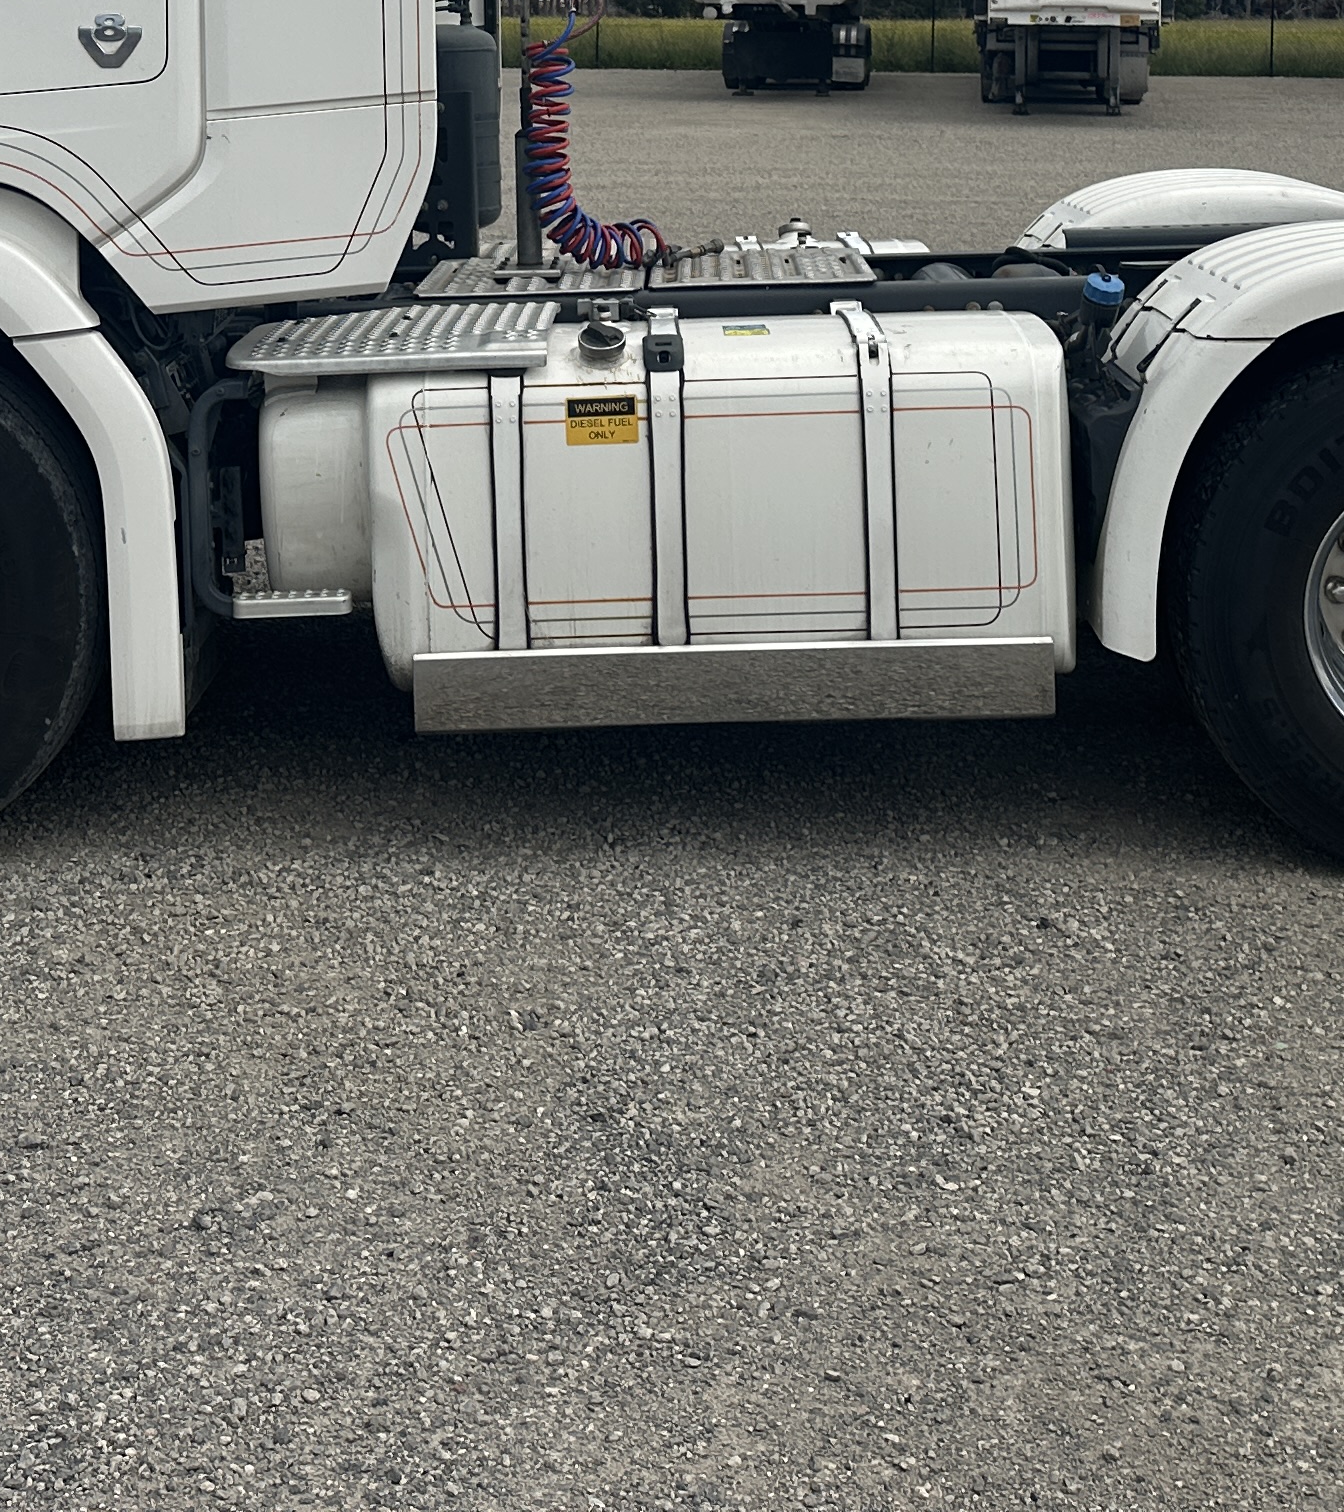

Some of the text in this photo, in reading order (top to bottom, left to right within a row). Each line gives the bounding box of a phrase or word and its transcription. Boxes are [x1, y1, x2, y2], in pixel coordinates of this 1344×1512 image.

[575, 402, 628, 413] WARNING
[570, 417, 633, 428] DIESEL FUEL
[588, 430, 615, 439] ONLY
